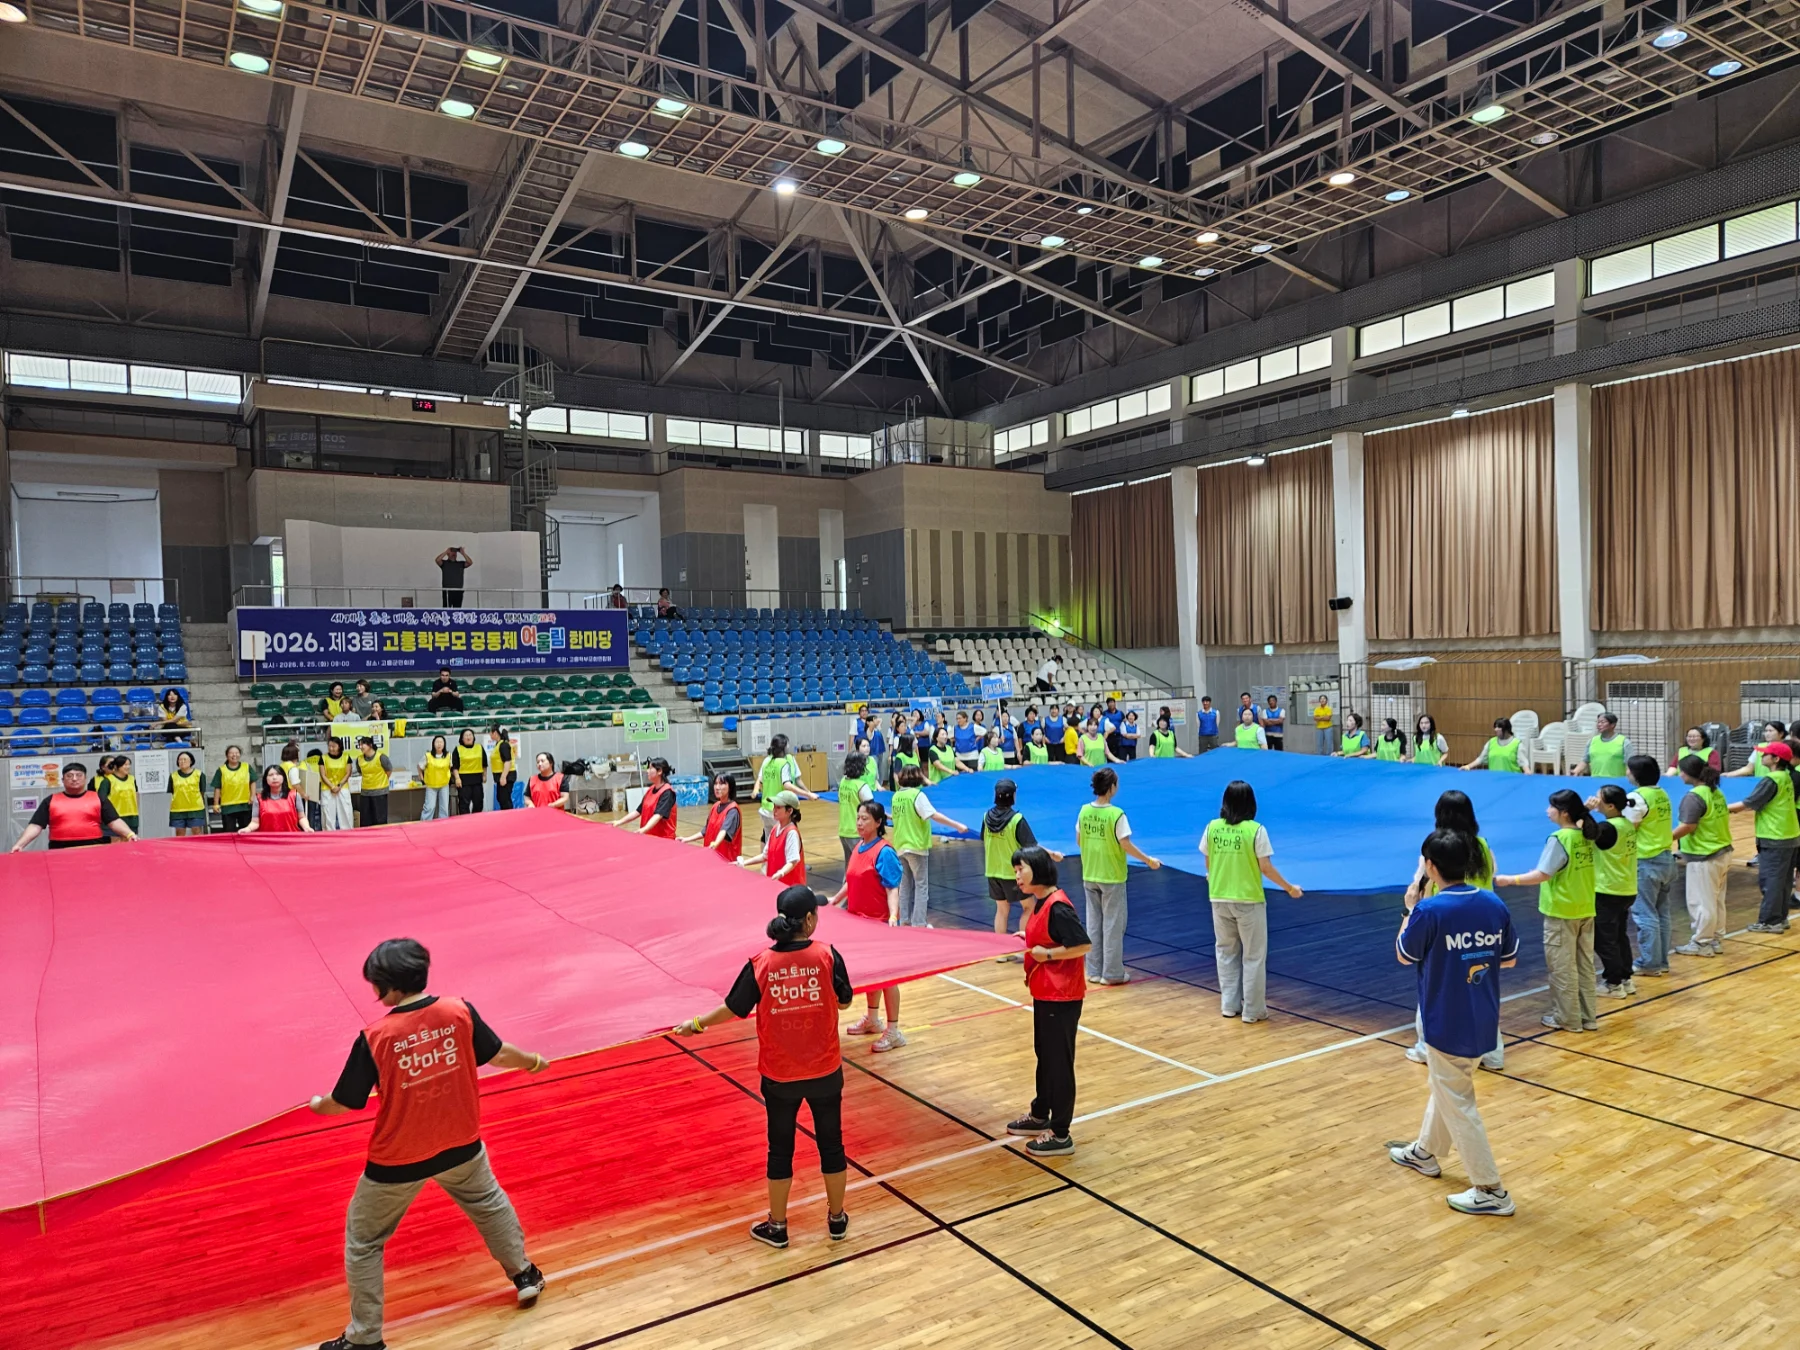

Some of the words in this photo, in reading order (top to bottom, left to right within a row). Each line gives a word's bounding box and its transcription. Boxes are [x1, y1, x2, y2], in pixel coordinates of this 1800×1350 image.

[265, 632, 324, 653] 2026.
[329, 632, 378, 652] 제3회
[383, 630, 466, 652] 고흥학부모
[470, 632, 517, 650] 공동체
[521, 625, 565, 654] 어울림
[569, 631, 612, 649] 한마당
[628, 720, 665, 734] 우주팀
[1213, 835, 1242, 850] 한마음
[1445, 932, 1473, 951] MC
[1474, 929, 1503, 946] Sori
[768, 966, 820, 982] 레크토피아
[769, 977, 821, 1004] 한마음
[393, 1024, 456, 1053] 레크토피아
[398, 1037, 458, 1076] 한마음
